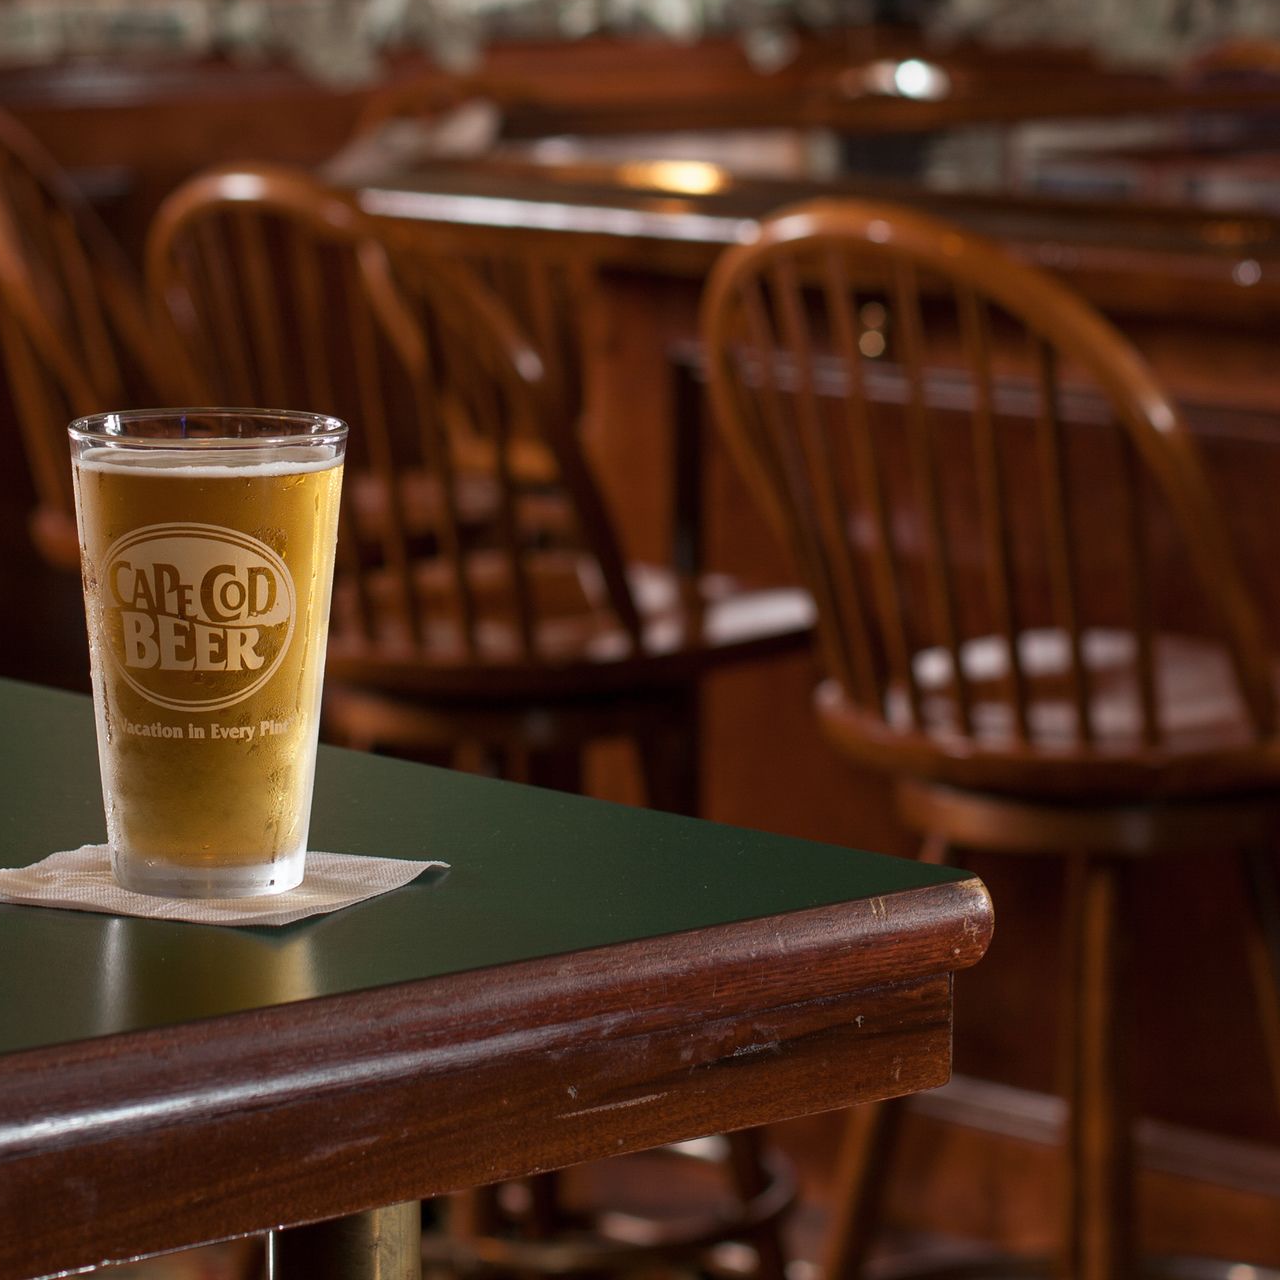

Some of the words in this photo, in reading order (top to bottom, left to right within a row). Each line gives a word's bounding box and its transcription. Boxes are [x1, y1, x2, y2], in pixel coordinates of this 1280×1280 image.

[110, 560, 198, 619] CAPE
[200, 564, 277, 622] COD
[121, 610, 265, 671] BEER
[120, 718, 183, 739] Vacation
[188, 723, 205, 739] in
[211, 723, 255, 742] Every
